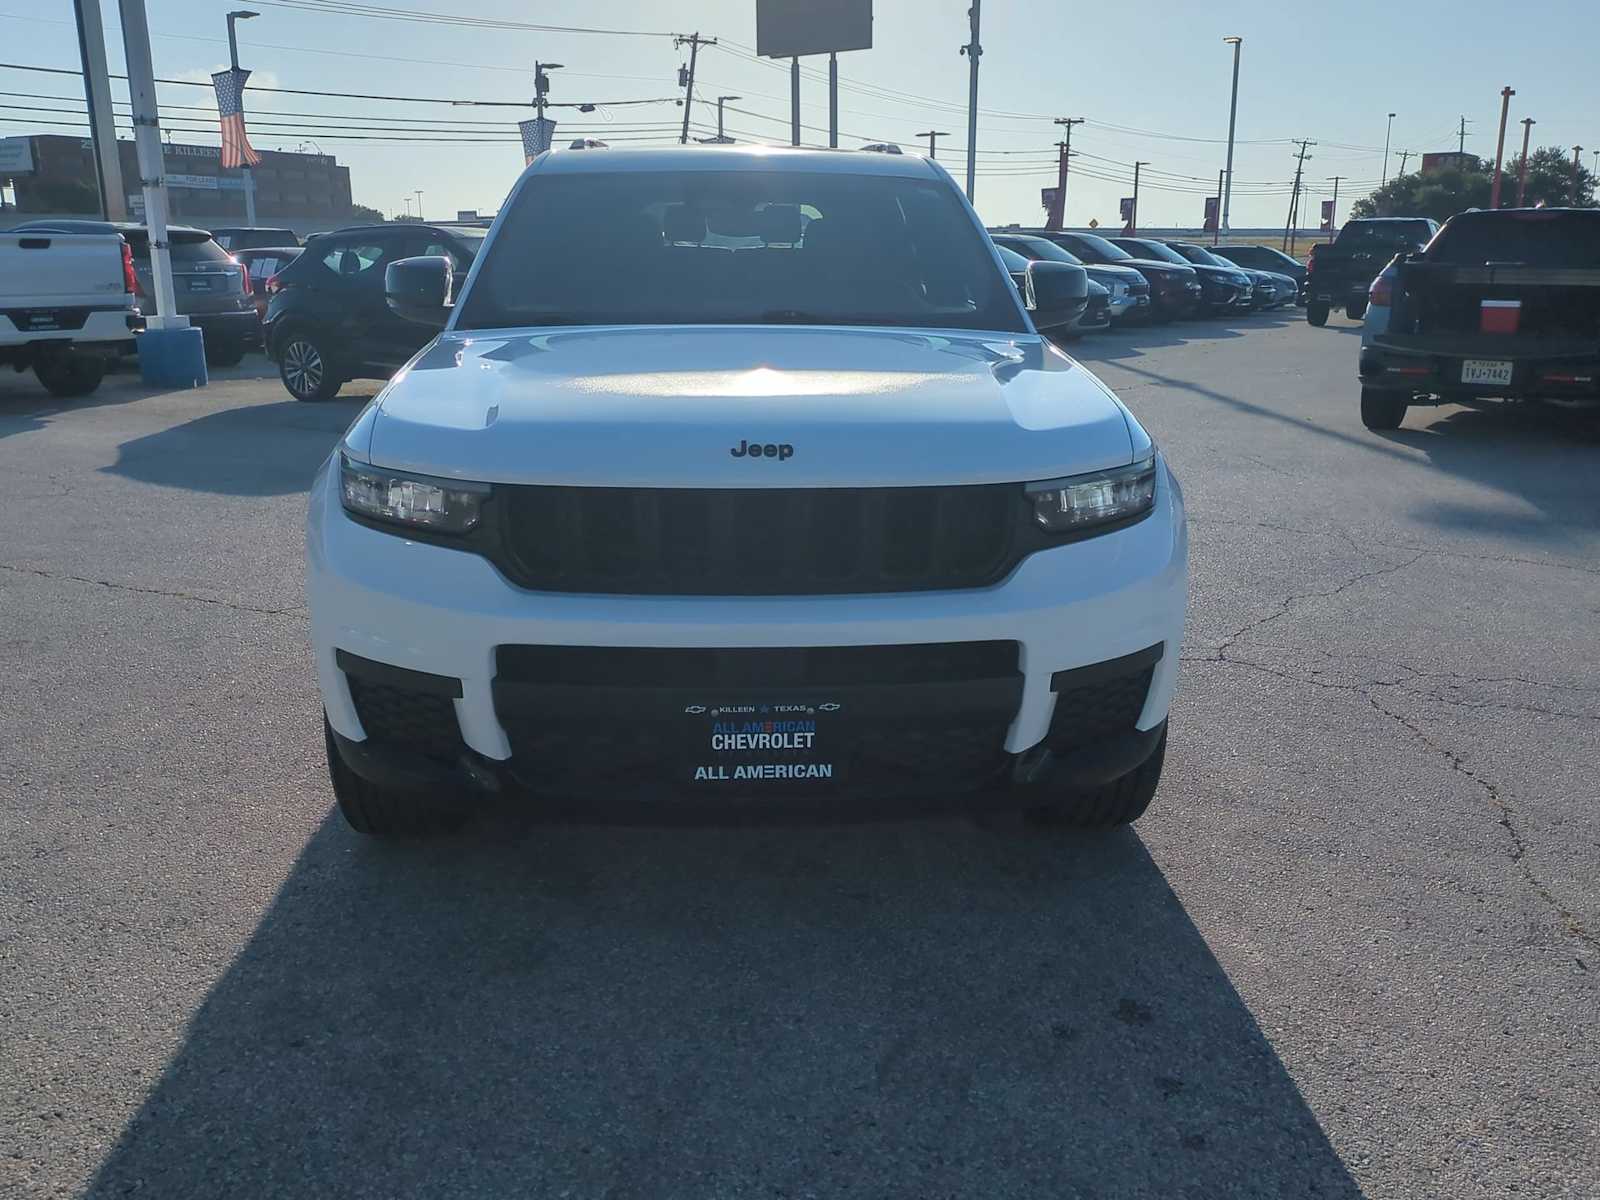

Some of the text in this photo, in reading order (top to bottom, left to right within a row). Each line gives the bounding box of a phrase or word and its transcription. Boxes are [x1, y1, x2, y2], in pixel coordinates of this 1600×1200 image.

[176, 146, 219, 159] KILLEEN
[731, 440, 793, 461] Jeep
[713, 720, 816, 733] ALL AMERICAN
[712, 732, 815, 750] CHEVROLET
[694, 764, 832, 780] ALL AMERICAN
